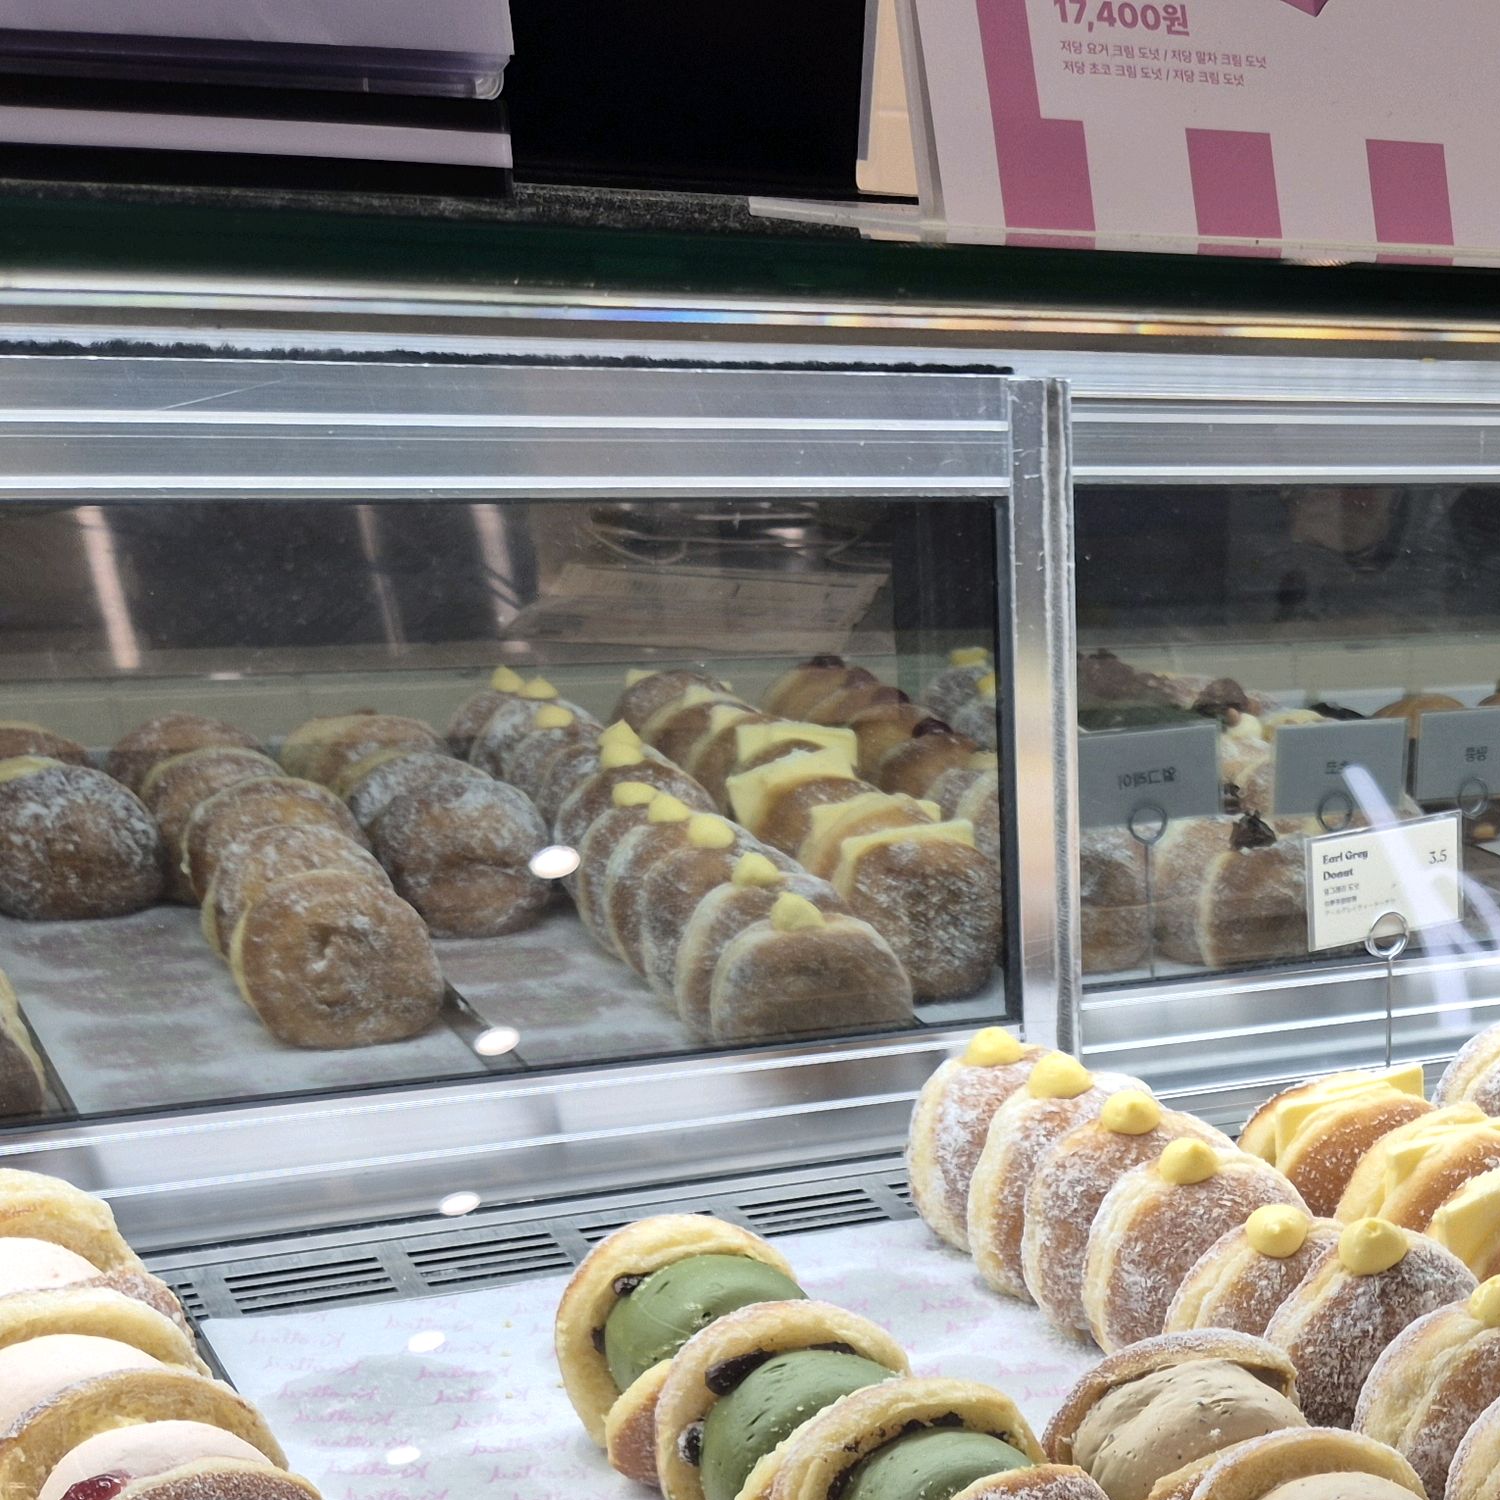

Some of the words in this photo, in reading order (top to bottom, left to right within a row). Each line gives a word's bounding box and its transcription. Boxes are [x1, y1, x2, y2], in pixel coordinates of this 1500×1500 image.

[1053, 0, 1190, 36] 17,400원
[1060, 40, 1082, 55] 저당
[1087, 42, 1109, 57] 요거
[1112, 44, 1135, 59] 크림
[1138, 46, 1160, 61] 도넛
[1171, 50, 1193, 64] 저당
[1221, 53, 1243, 67] 크림
[1245, 55, 1268, 69] 도넛
[1063, 60, 1085, 75] 저당
[1089, 62, 1111, 76] 초코
[1115, 64, 1137, 79] 크림
[1140, 67, 1163, 81] 도넛
[1173, 69, 1195, 84] 저당
[1199, 71, 1220, 85] 크림
[1223, 73, 1245, 87] 도넛
[1322, 851, 1343, 865] Earl
[1345, 849, 1368, 862] Grey
[1428, 849, 1448, 865] 3.5
[1323, 868, 1354, 881] Donut
